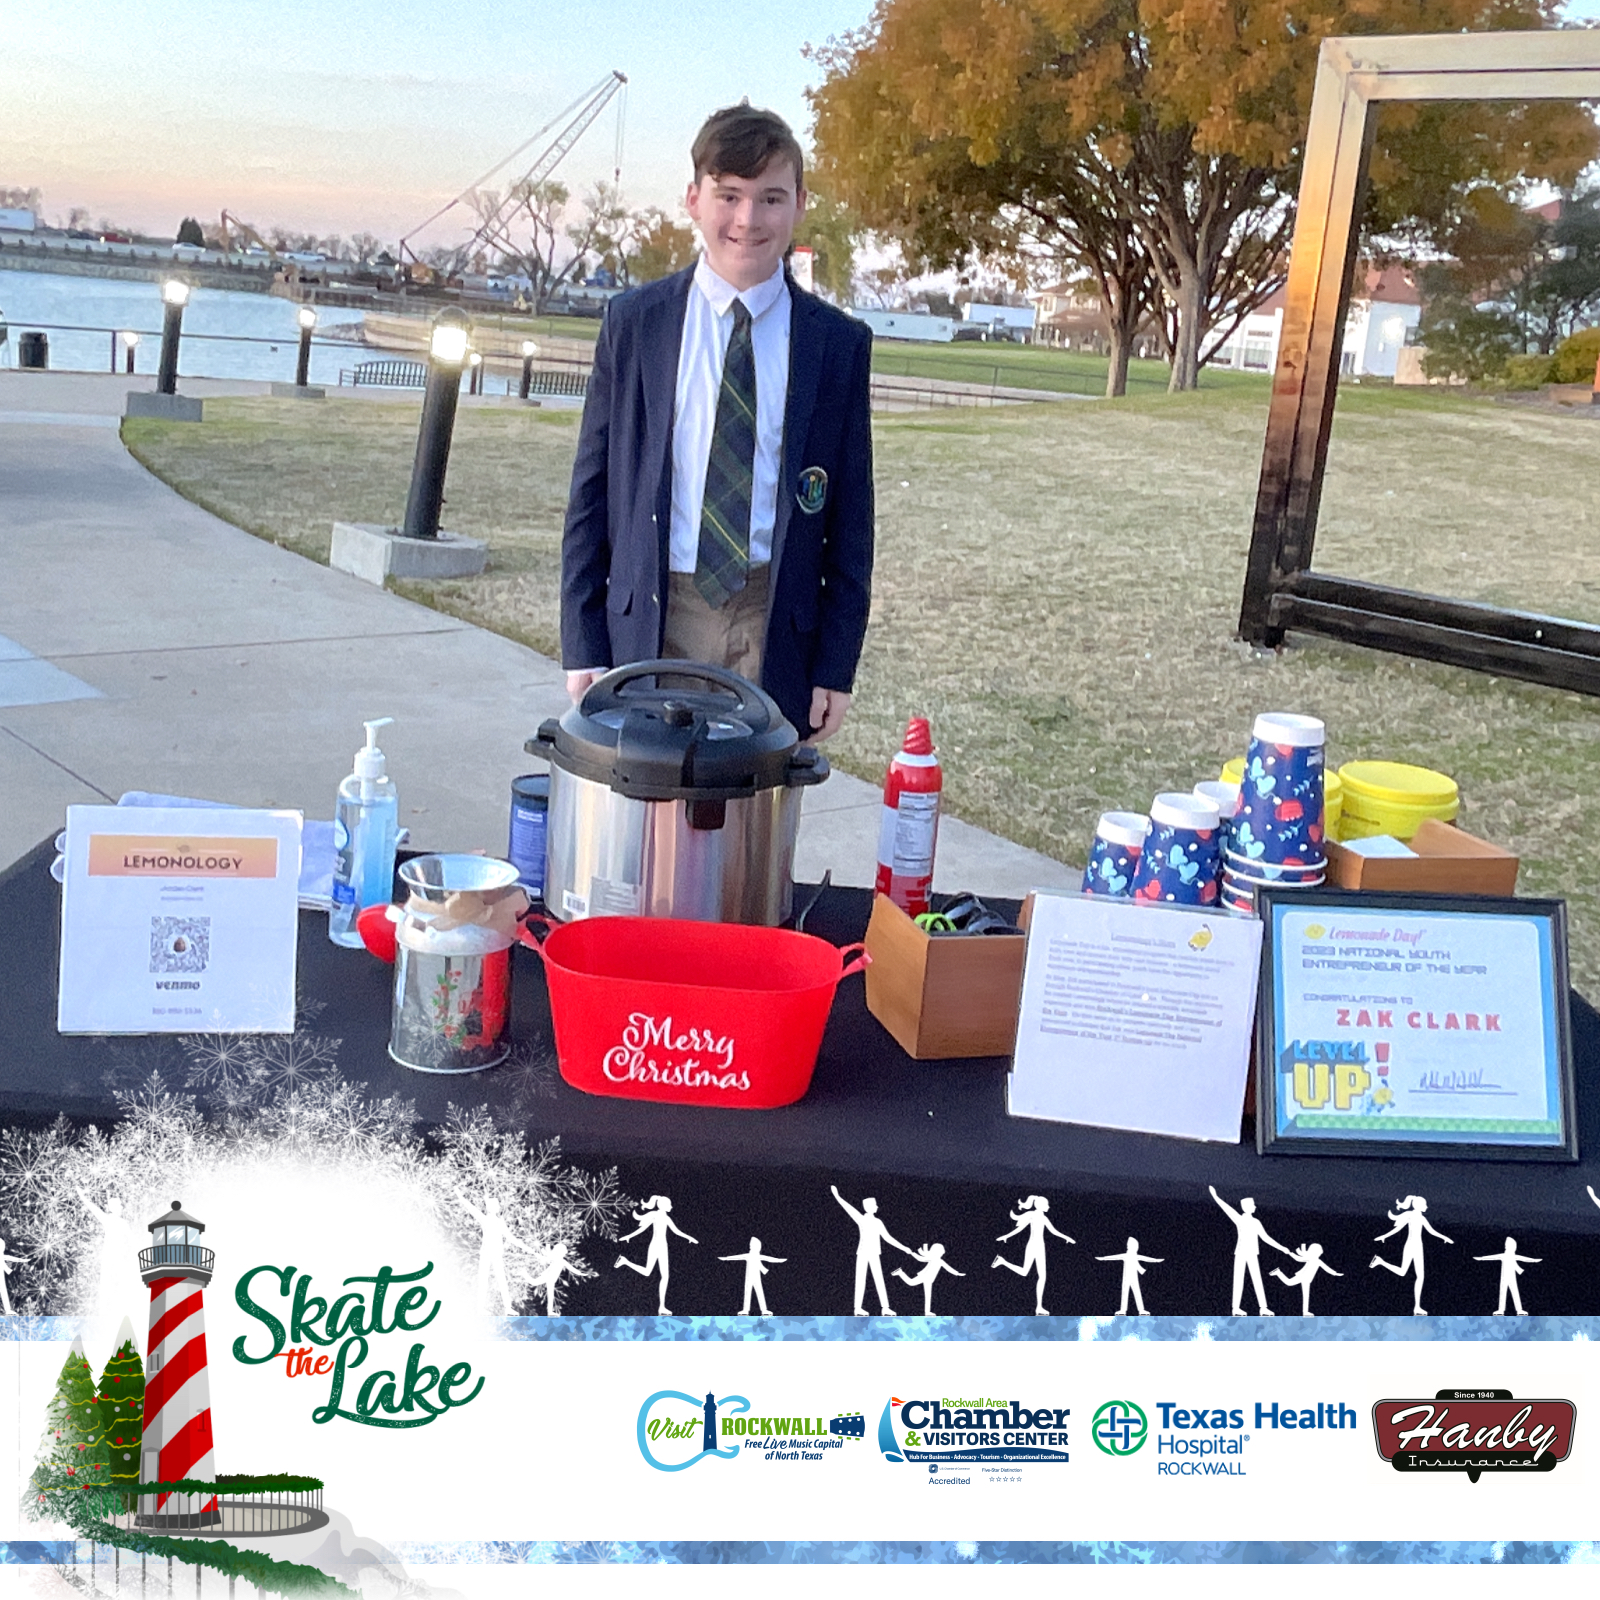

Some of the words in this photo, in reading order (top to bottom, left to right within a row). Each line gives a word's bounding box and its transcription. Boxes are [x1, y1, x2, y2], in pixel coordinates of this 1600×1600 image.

[123, 855, 243, 870] LEMONOLOGY
[1329, 926, 1390, 941] Lemonade
[1302, 945, 1335, 956] 2023
[1338, 946, 1405, 959] NATIONAL
[1408, 949, 1452, 960] YOUTH
[1302, 958, 1402, 972] ENTREPRENEUR
[1405, 962, 1422, 973] OF
[1426, 963, 1451, 974] THE
[1454, 964, 1488, 975] YEAR
[155, 980, 201, 991] venmo
[1303, 992, 1398, 1005] CONGRATULATIONS
[1400, 995, 1413, 1006] TO
[1336, 1008, 1393, 1029] ZAK
[1407, 1011, 1502, 1032] CLARK
[622, 1012, 735, 1069] Merry
[1291, 1038, 1371, 1063] LEVEL
[602, 1045, 751, 1091] Christmas
